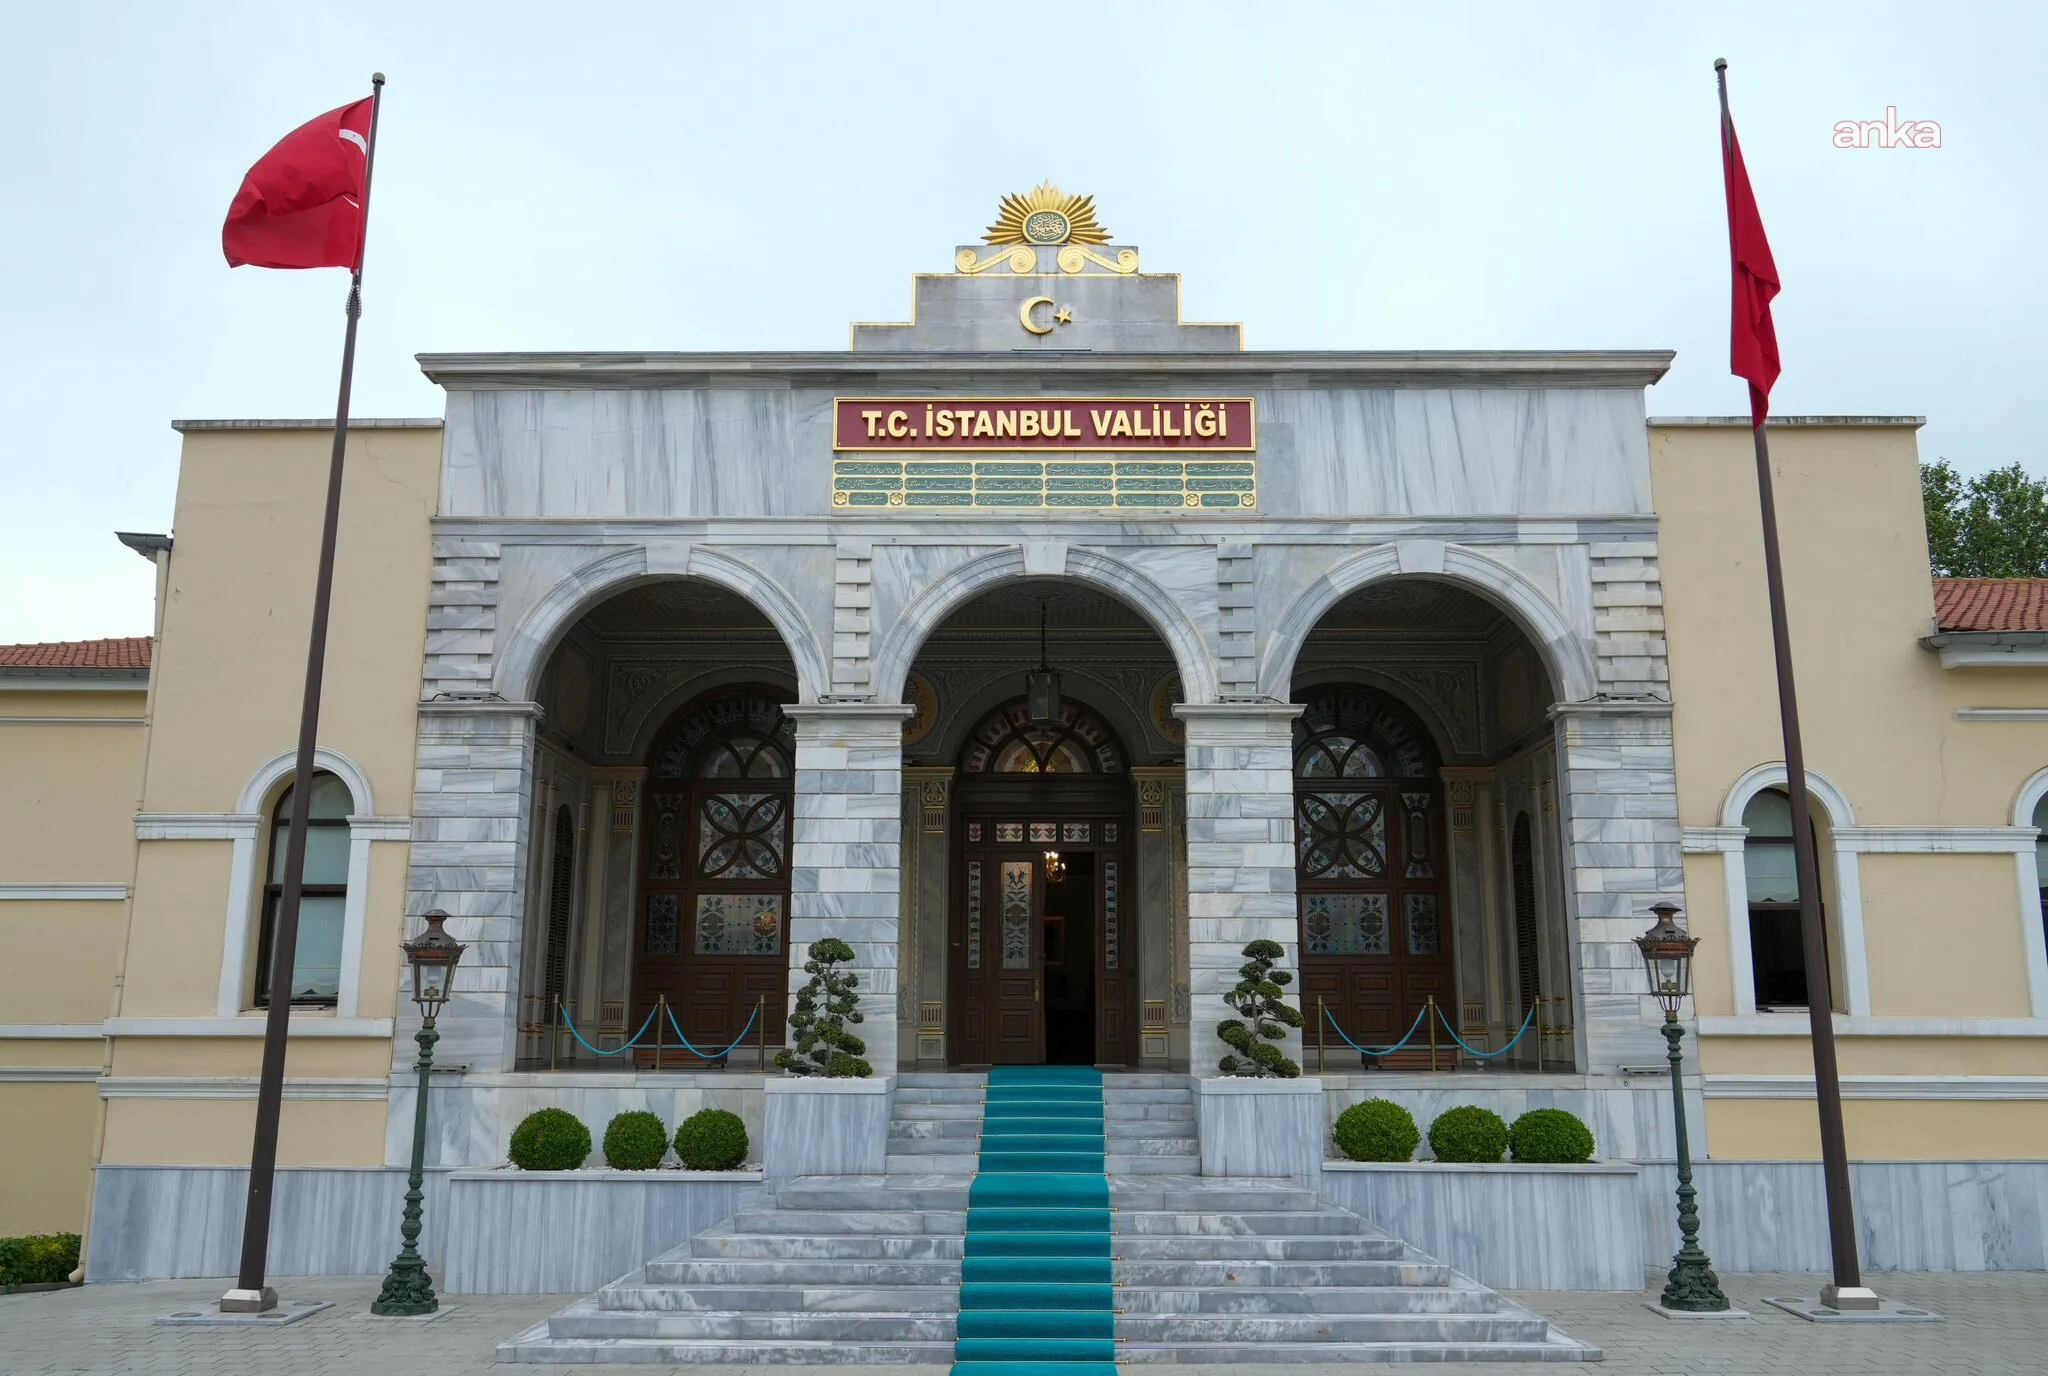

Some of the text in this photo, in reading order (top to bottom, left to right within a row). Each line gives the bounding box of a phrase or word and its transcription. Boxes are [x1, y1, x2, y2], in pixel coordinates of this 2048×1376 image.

[861, 402, 1228, 438] T.C. İSTANBUL VALİLİĞİ
